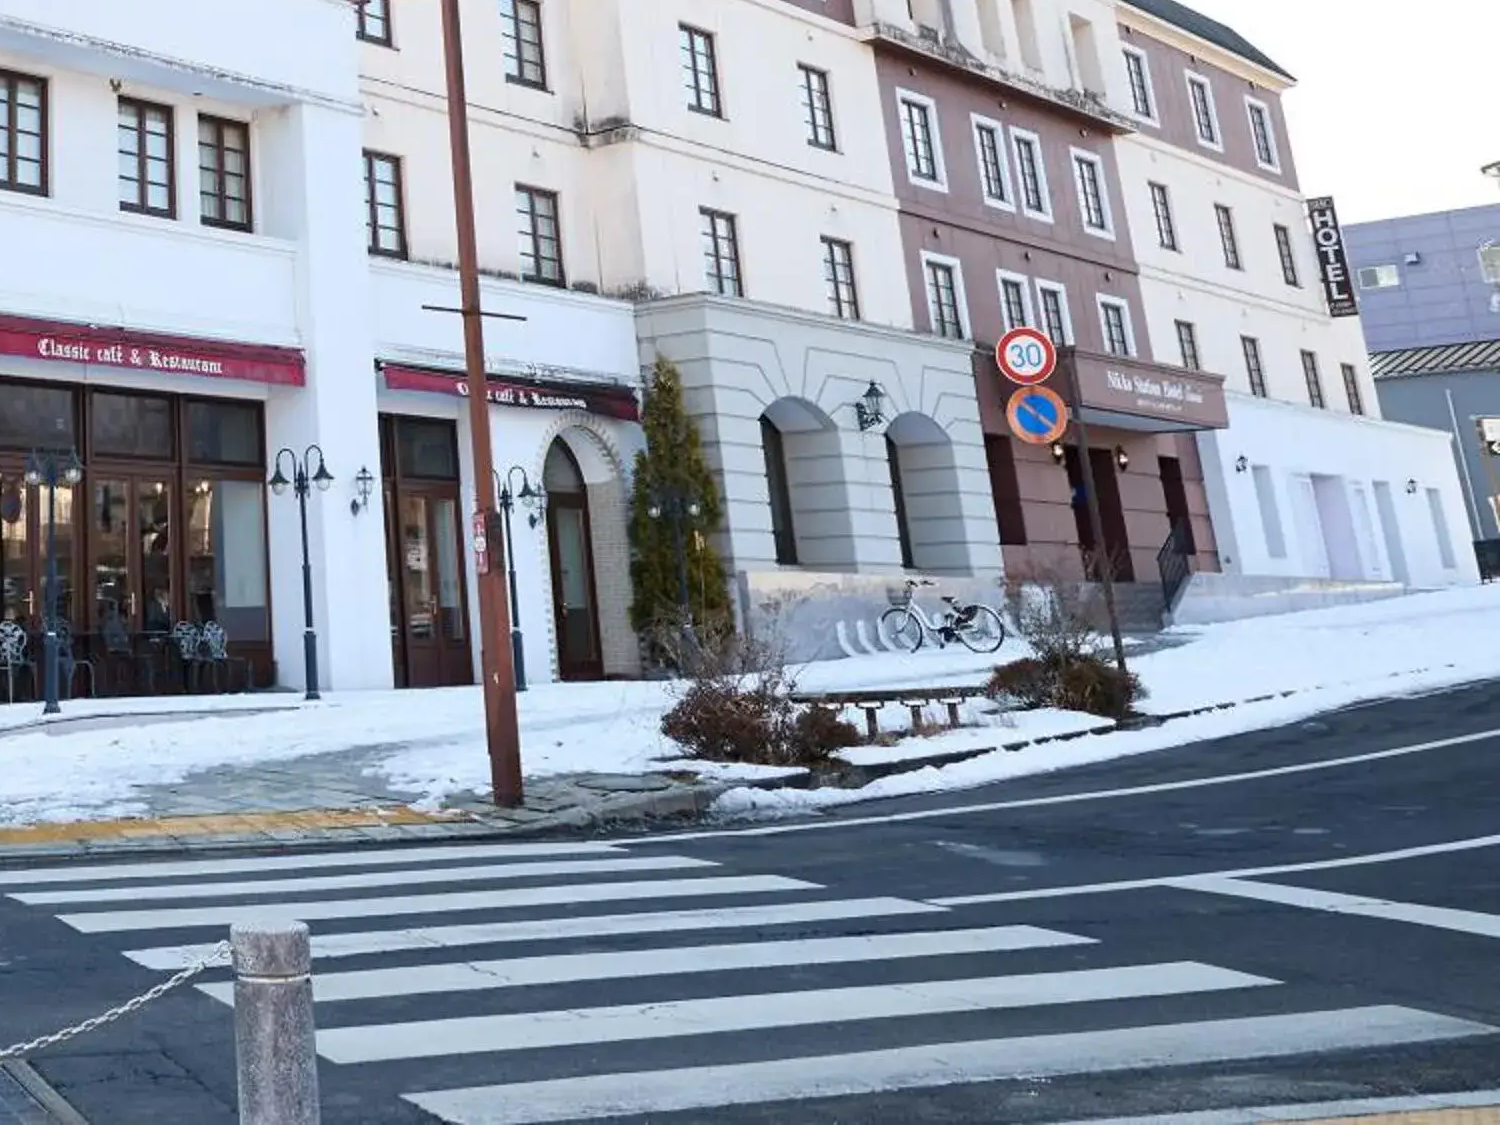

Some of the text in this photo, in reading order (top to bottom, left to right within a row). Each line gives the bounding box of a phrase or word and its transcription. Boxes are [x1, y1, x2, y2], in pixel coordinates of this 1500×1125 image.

[1311, 209, 1349, 300] HOTEL
[37, 338, 91, 361] Classic
[129, 348, 143, 366] &
[150, 349, 223, 374] Restaurant
[1010, 343, 1042, 368] 30
